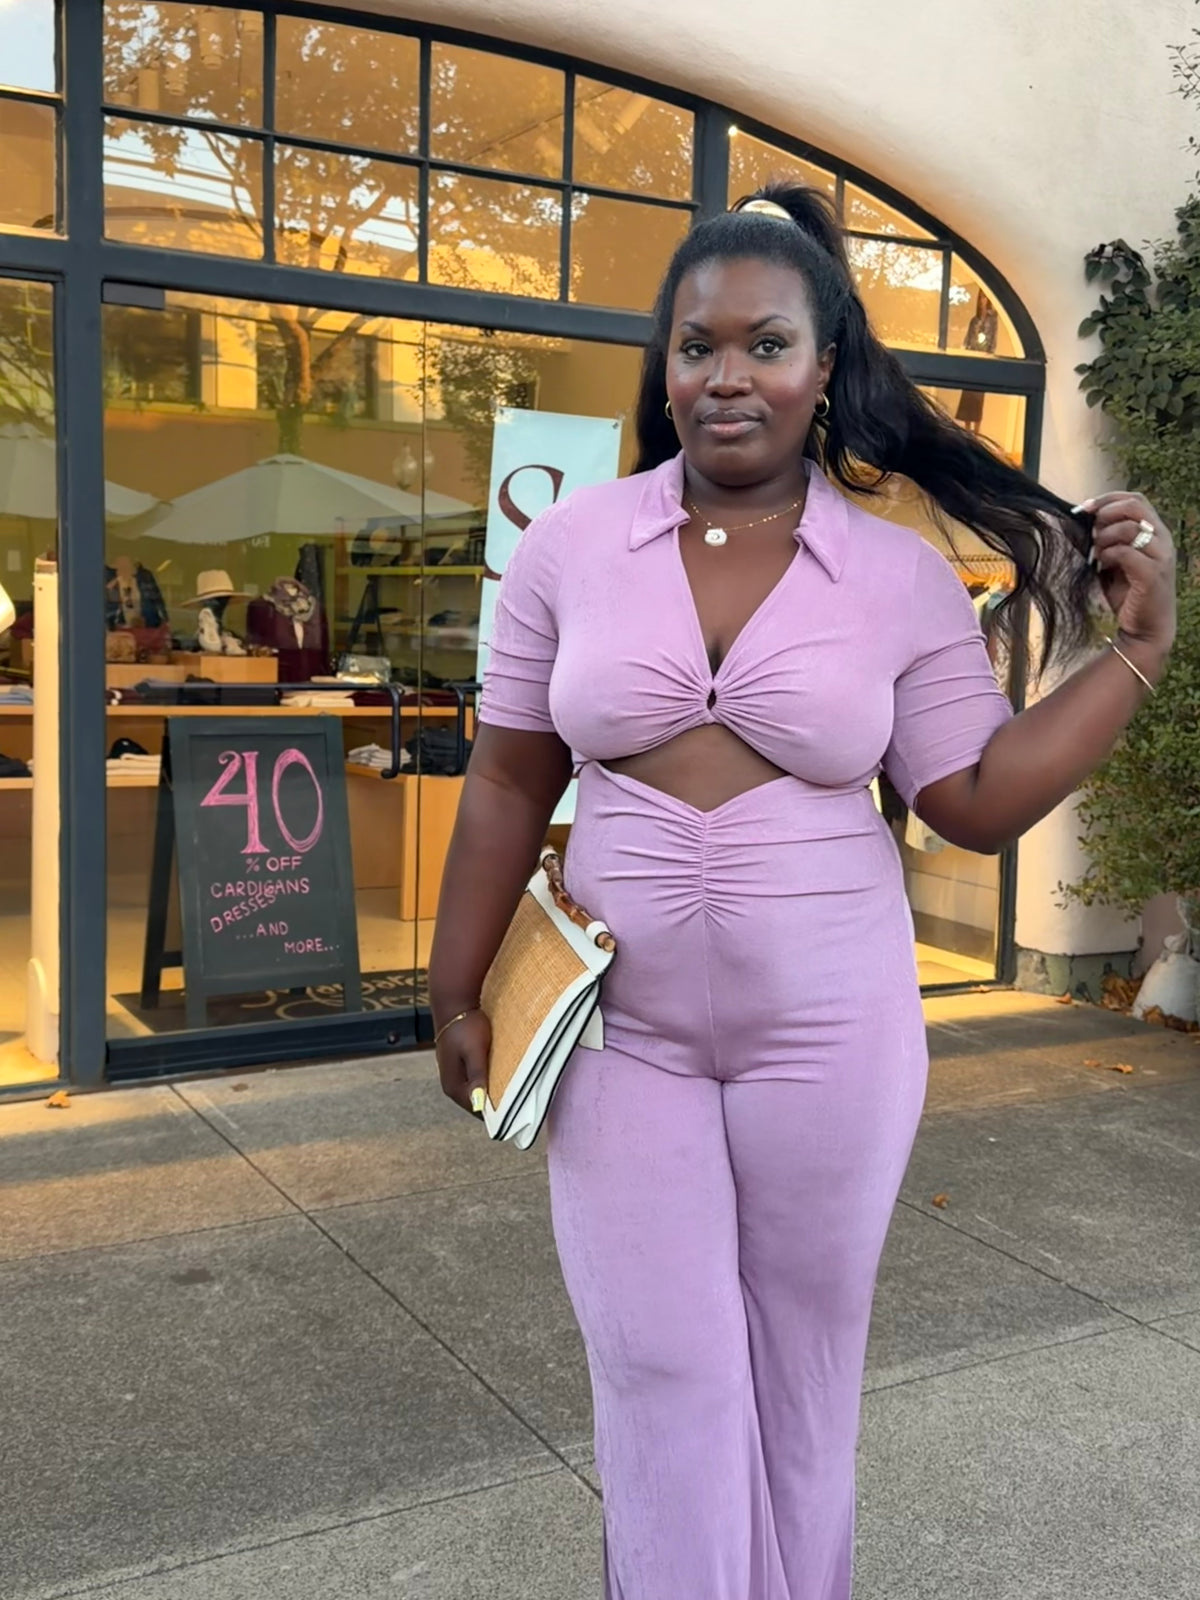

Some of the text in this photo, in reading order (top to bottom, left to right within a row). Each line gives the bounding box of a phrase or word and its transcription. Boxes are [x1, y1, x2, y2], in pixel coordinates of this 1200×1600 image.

[201, 748, 324, 853] 40
[266, 856, 302, 872] OFF
[210, 878, 310, 898] CARDIGANS
[210, 885, 276, 933] DRESSES
[284, 938, 340, 953] MORE...
